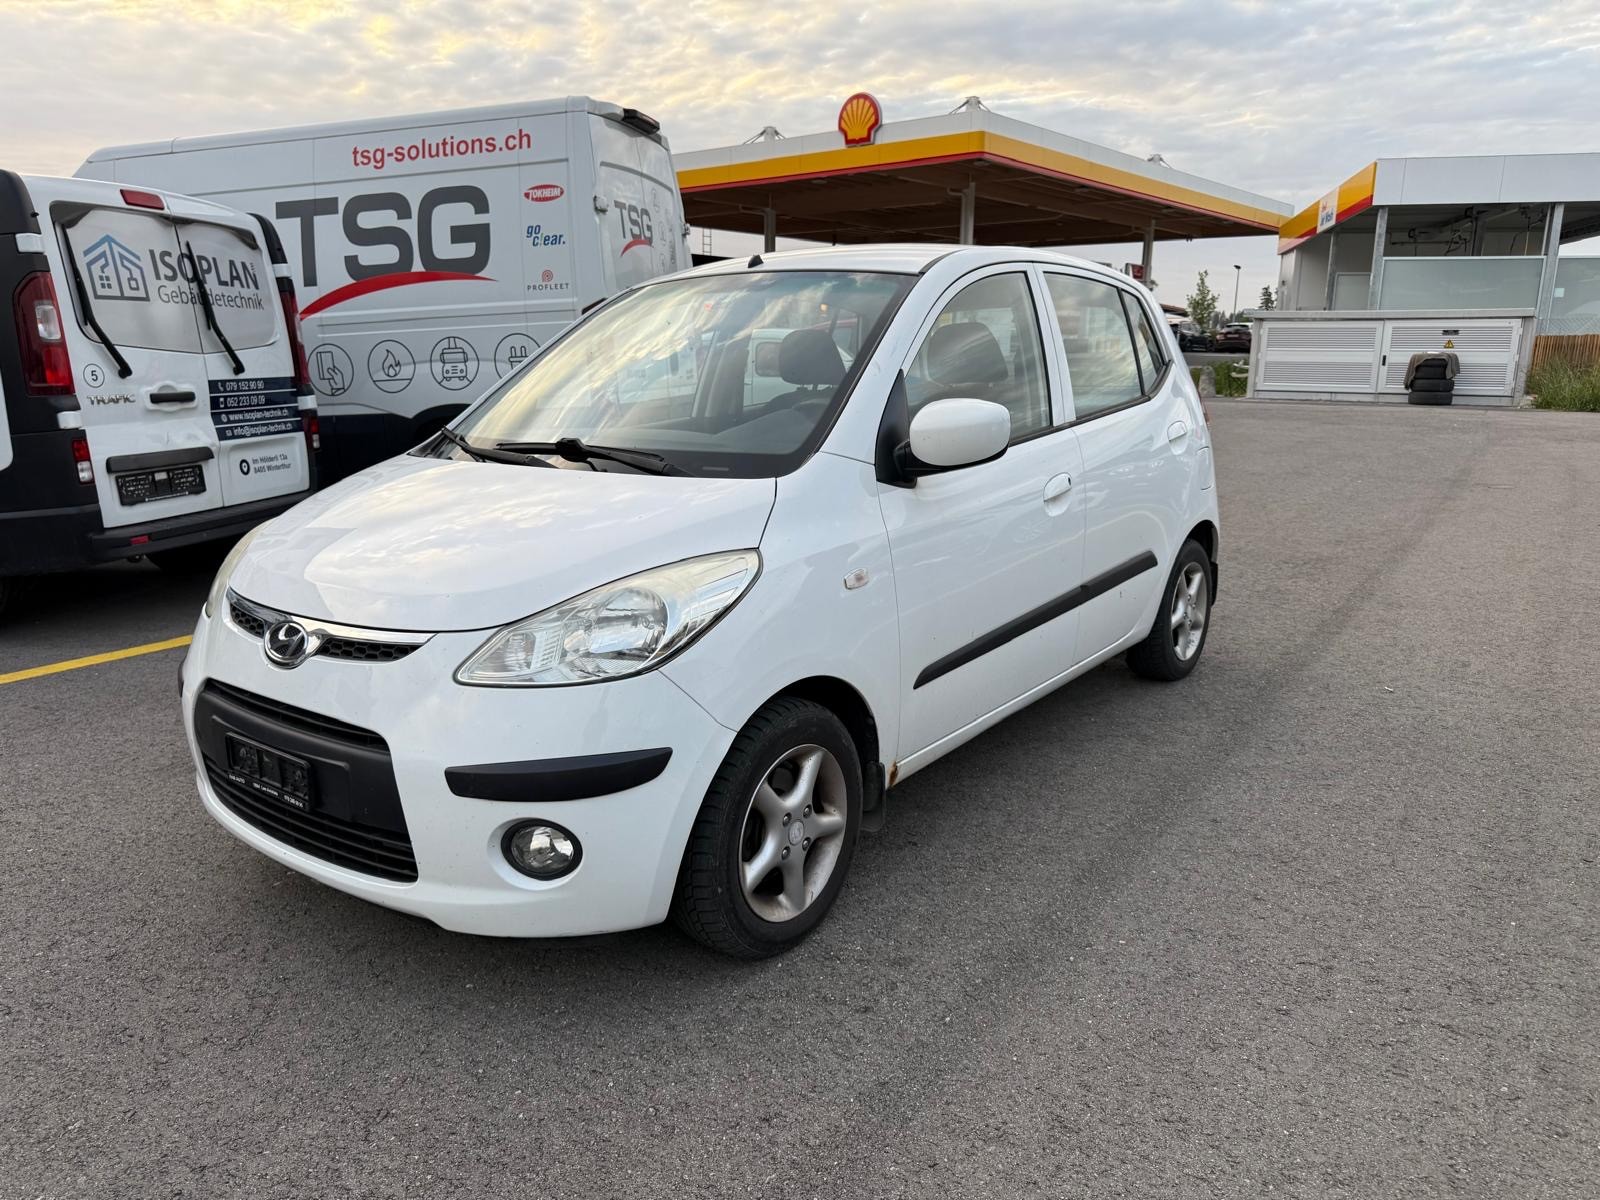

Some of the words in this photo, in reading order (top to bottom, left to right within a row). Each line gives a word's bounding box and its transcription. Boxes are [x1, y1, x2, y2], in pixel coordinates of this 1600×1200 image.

[352, 128, 532, 170] tsg-solutions.ch
[525, 186, 562, 200] TOKHEIM
[613, 200, 653, 246] TSG
[275, 185, 491, 288] TSG
[526, 224, 541, 239] go
[148, 249, 260, 290] ISOPLAN
[527, 282, 570, 291] PROFLEET
[157, 284, 264, 311] Gebädetechnik
[91, 370, 98, 382] 5
[226, 382, 238, 391] 079
[239, 381, 249, 390] 152
[87, 394, 136, 406] TRAFIC
[240, 396, 250, 406] 233
[228, 408, 289, 421] www.isoplan-technik.ch
